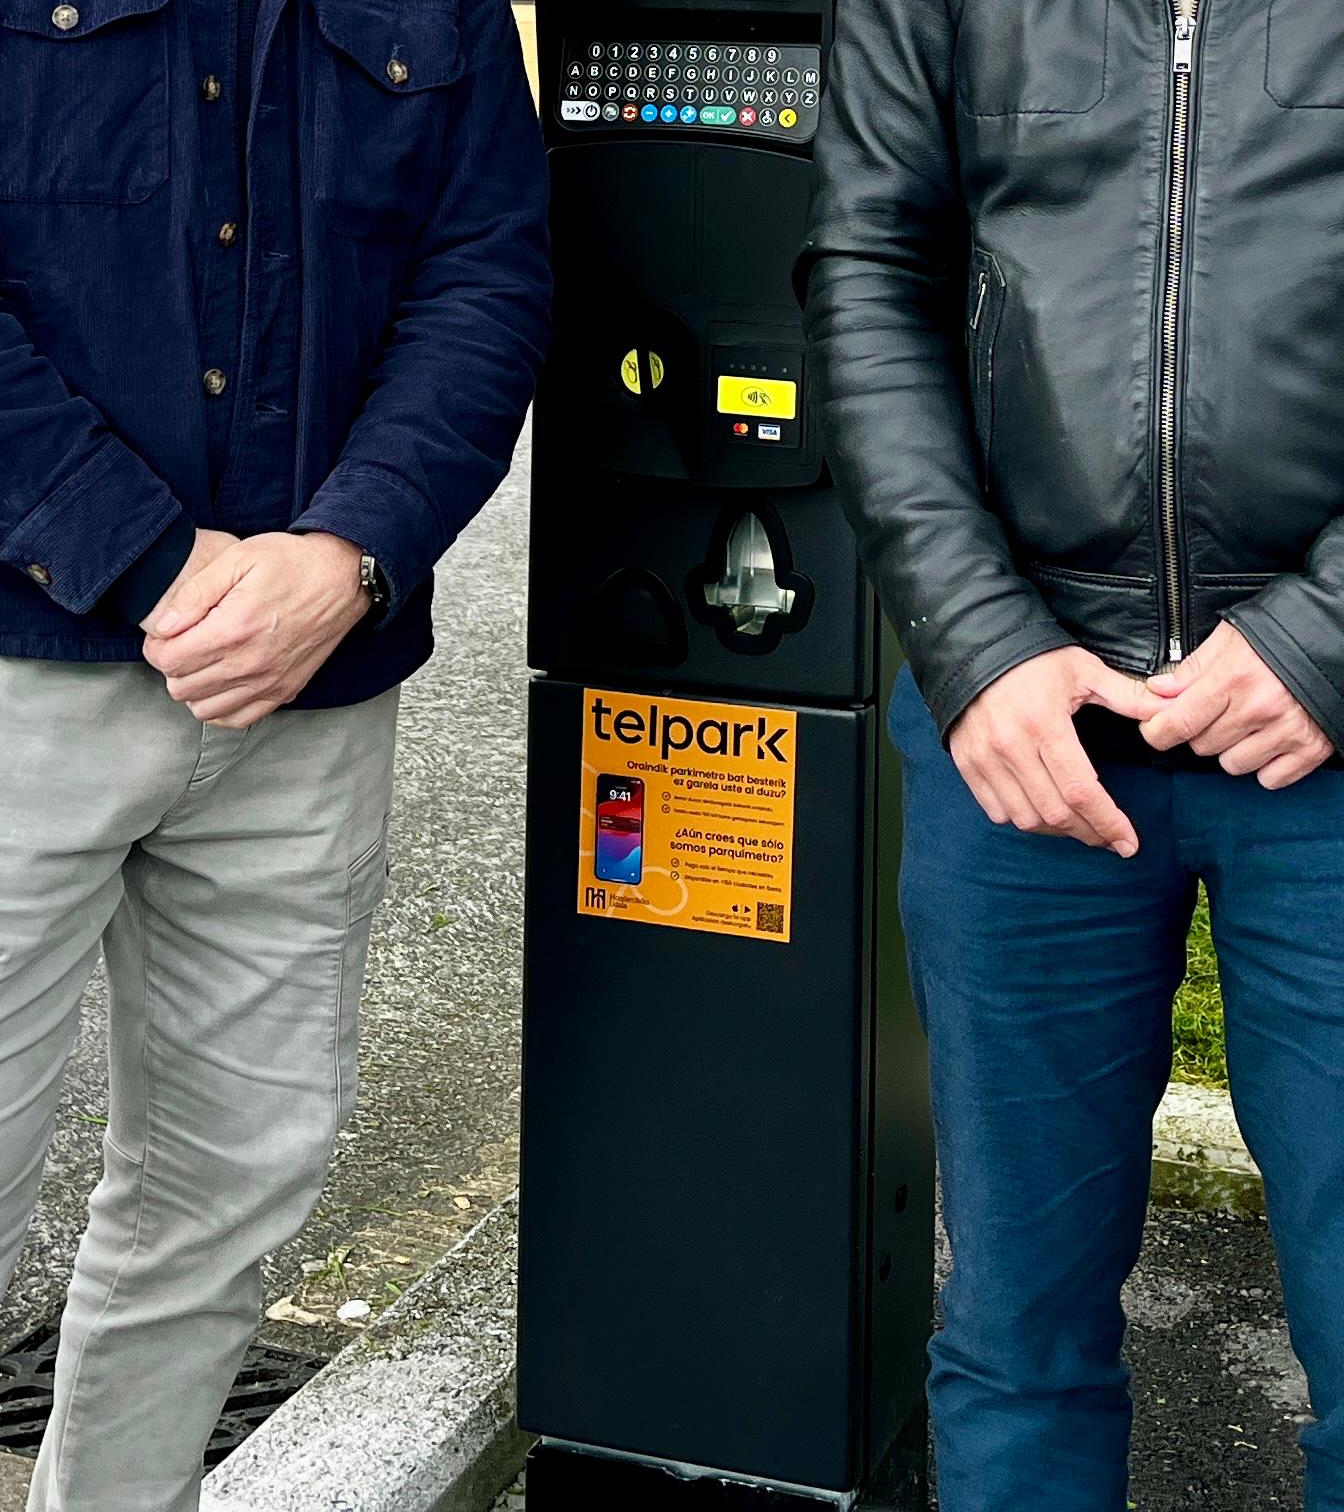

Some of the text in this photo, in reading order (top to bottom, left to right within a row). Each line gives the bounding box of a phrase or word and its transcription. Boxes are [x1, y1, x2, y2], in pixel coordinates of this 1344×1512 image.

[702, 111, 715, 119] OK
[591, 697, 789, 763] telpark
[727, 772, 745, 784] bat
[609, 789, 631, 802] 9:41
[675, 828, 703, 839] ¿Aún
[737, 836, 759, 848] que
[761, 837, 784, 850] sólo
[670, 841, 784, 864] somos parquímetro?
